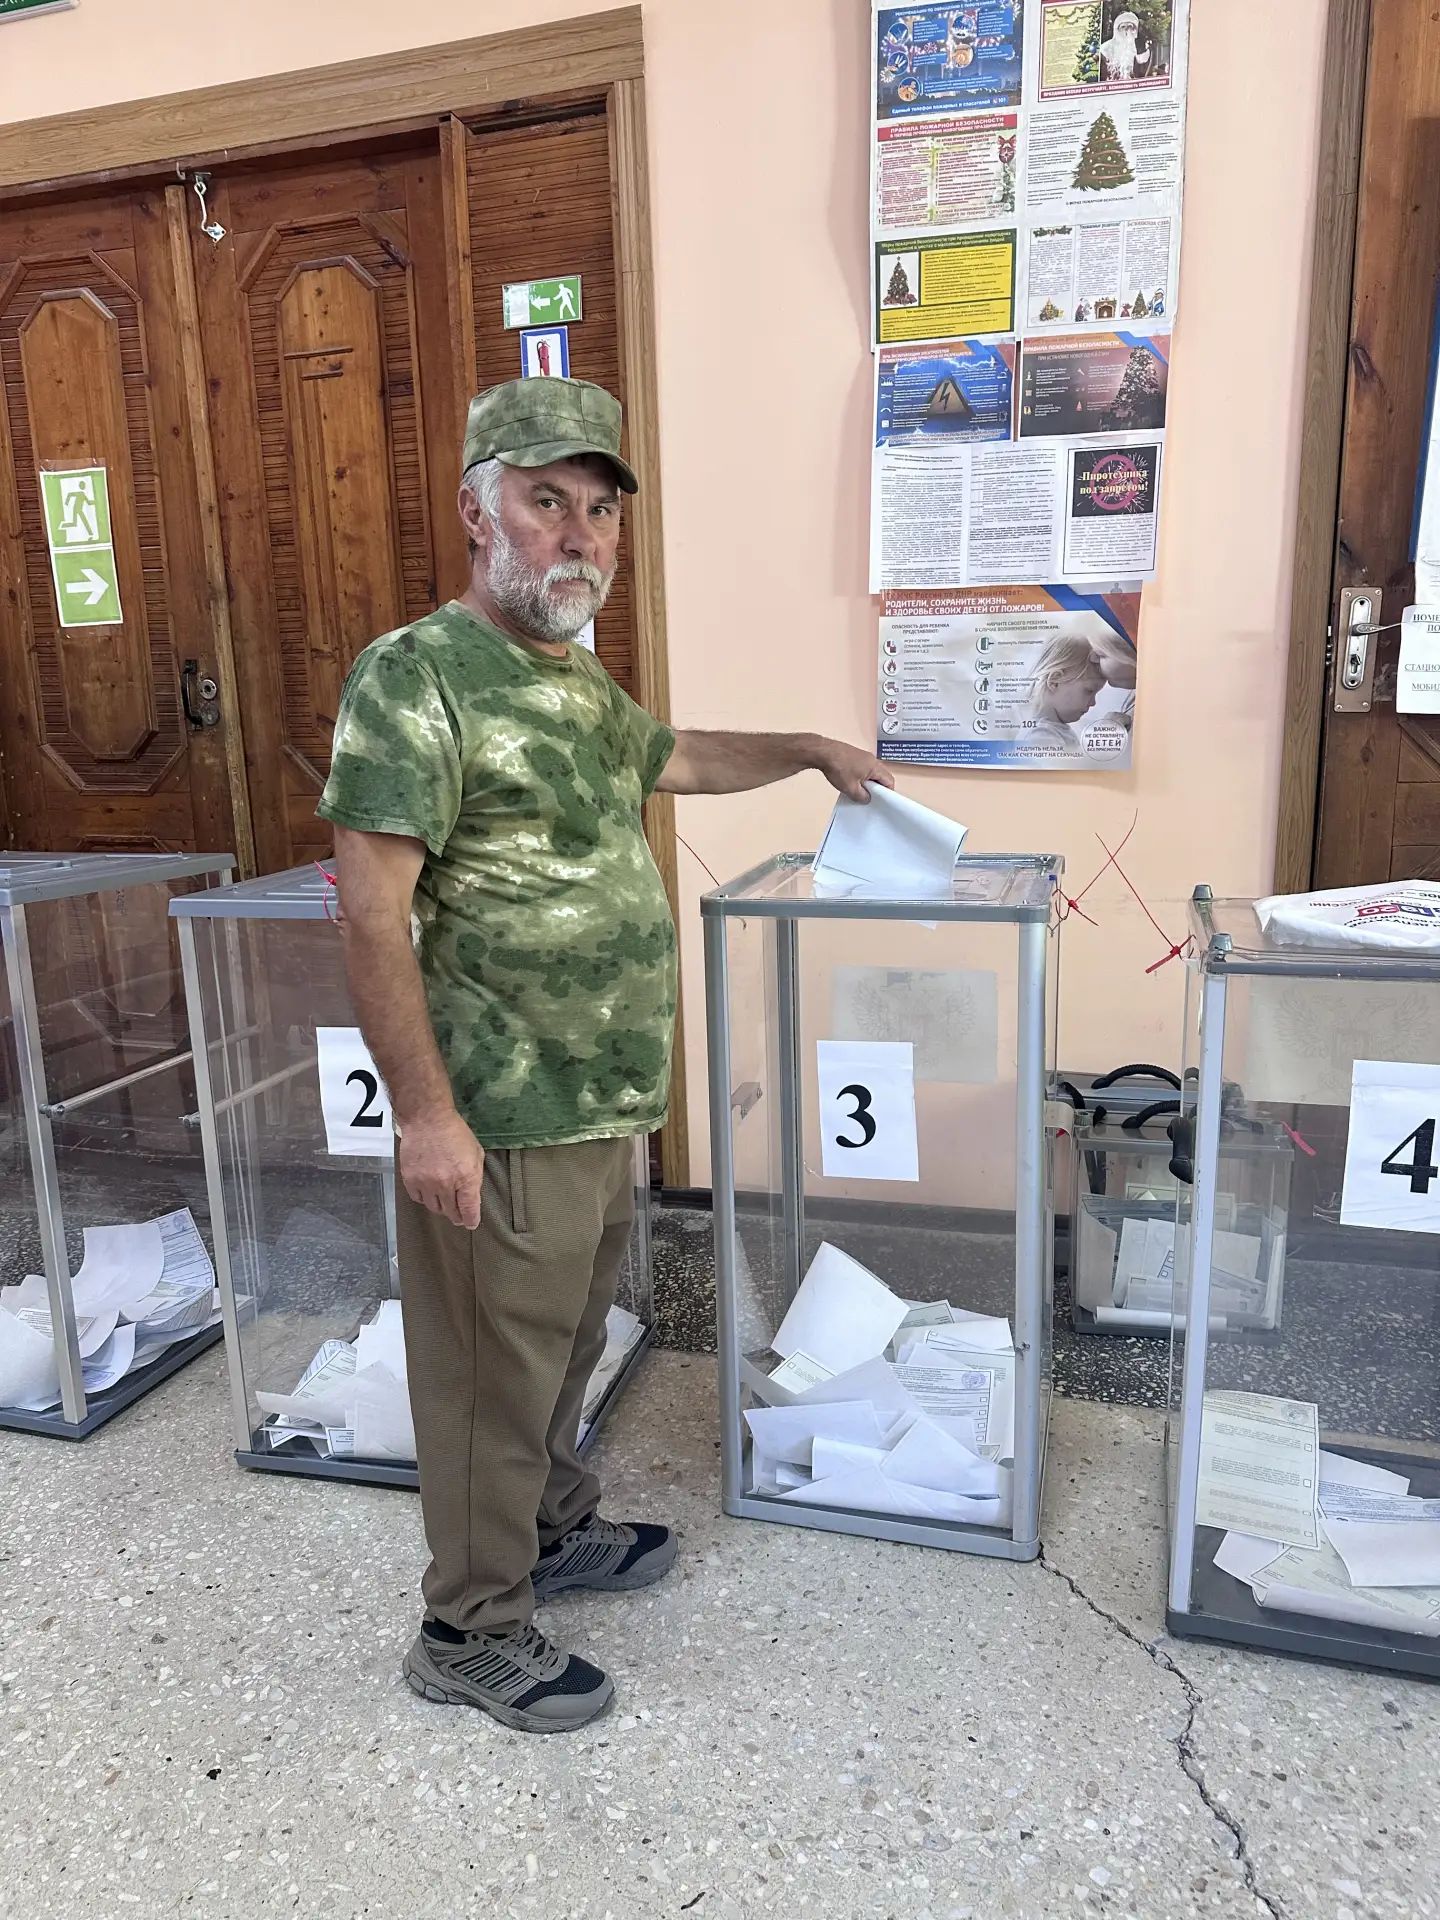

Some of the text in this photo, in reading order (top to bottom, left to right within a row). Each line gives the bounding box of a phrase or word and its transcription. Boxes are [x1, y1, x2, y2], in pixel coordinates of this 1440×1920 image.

[956, 118, 1004, 127] БЕЗОПАСНОСТИ
[1083, 470, 1147, 481] Пиротехника
[1098, 481, 1148, 494] запретом!
[885, 597, 1007, 608] РОДИТЕЛИ, СОХРАНИТЕ ЖИЗНЬ
[893, 607, 933, 616] ЗДОРОВЬЕ
[935, 606, 961, 614] СВОИХ
[962, 605, 988, 614] ДЕТЕЙ
[989, 605, 999, 613] ОТ
[1001, 604, 1045, 612] ПОЖАРОВ!
[1087, 737, 1122, 747] ДЕТЕЙ
[1362, 906, 1396, 914] 20
[346, 1069, 383, 1127] 2
[835, 1084, 877, 1148] 3
[1381, 1118, 1439, 1194] 4
